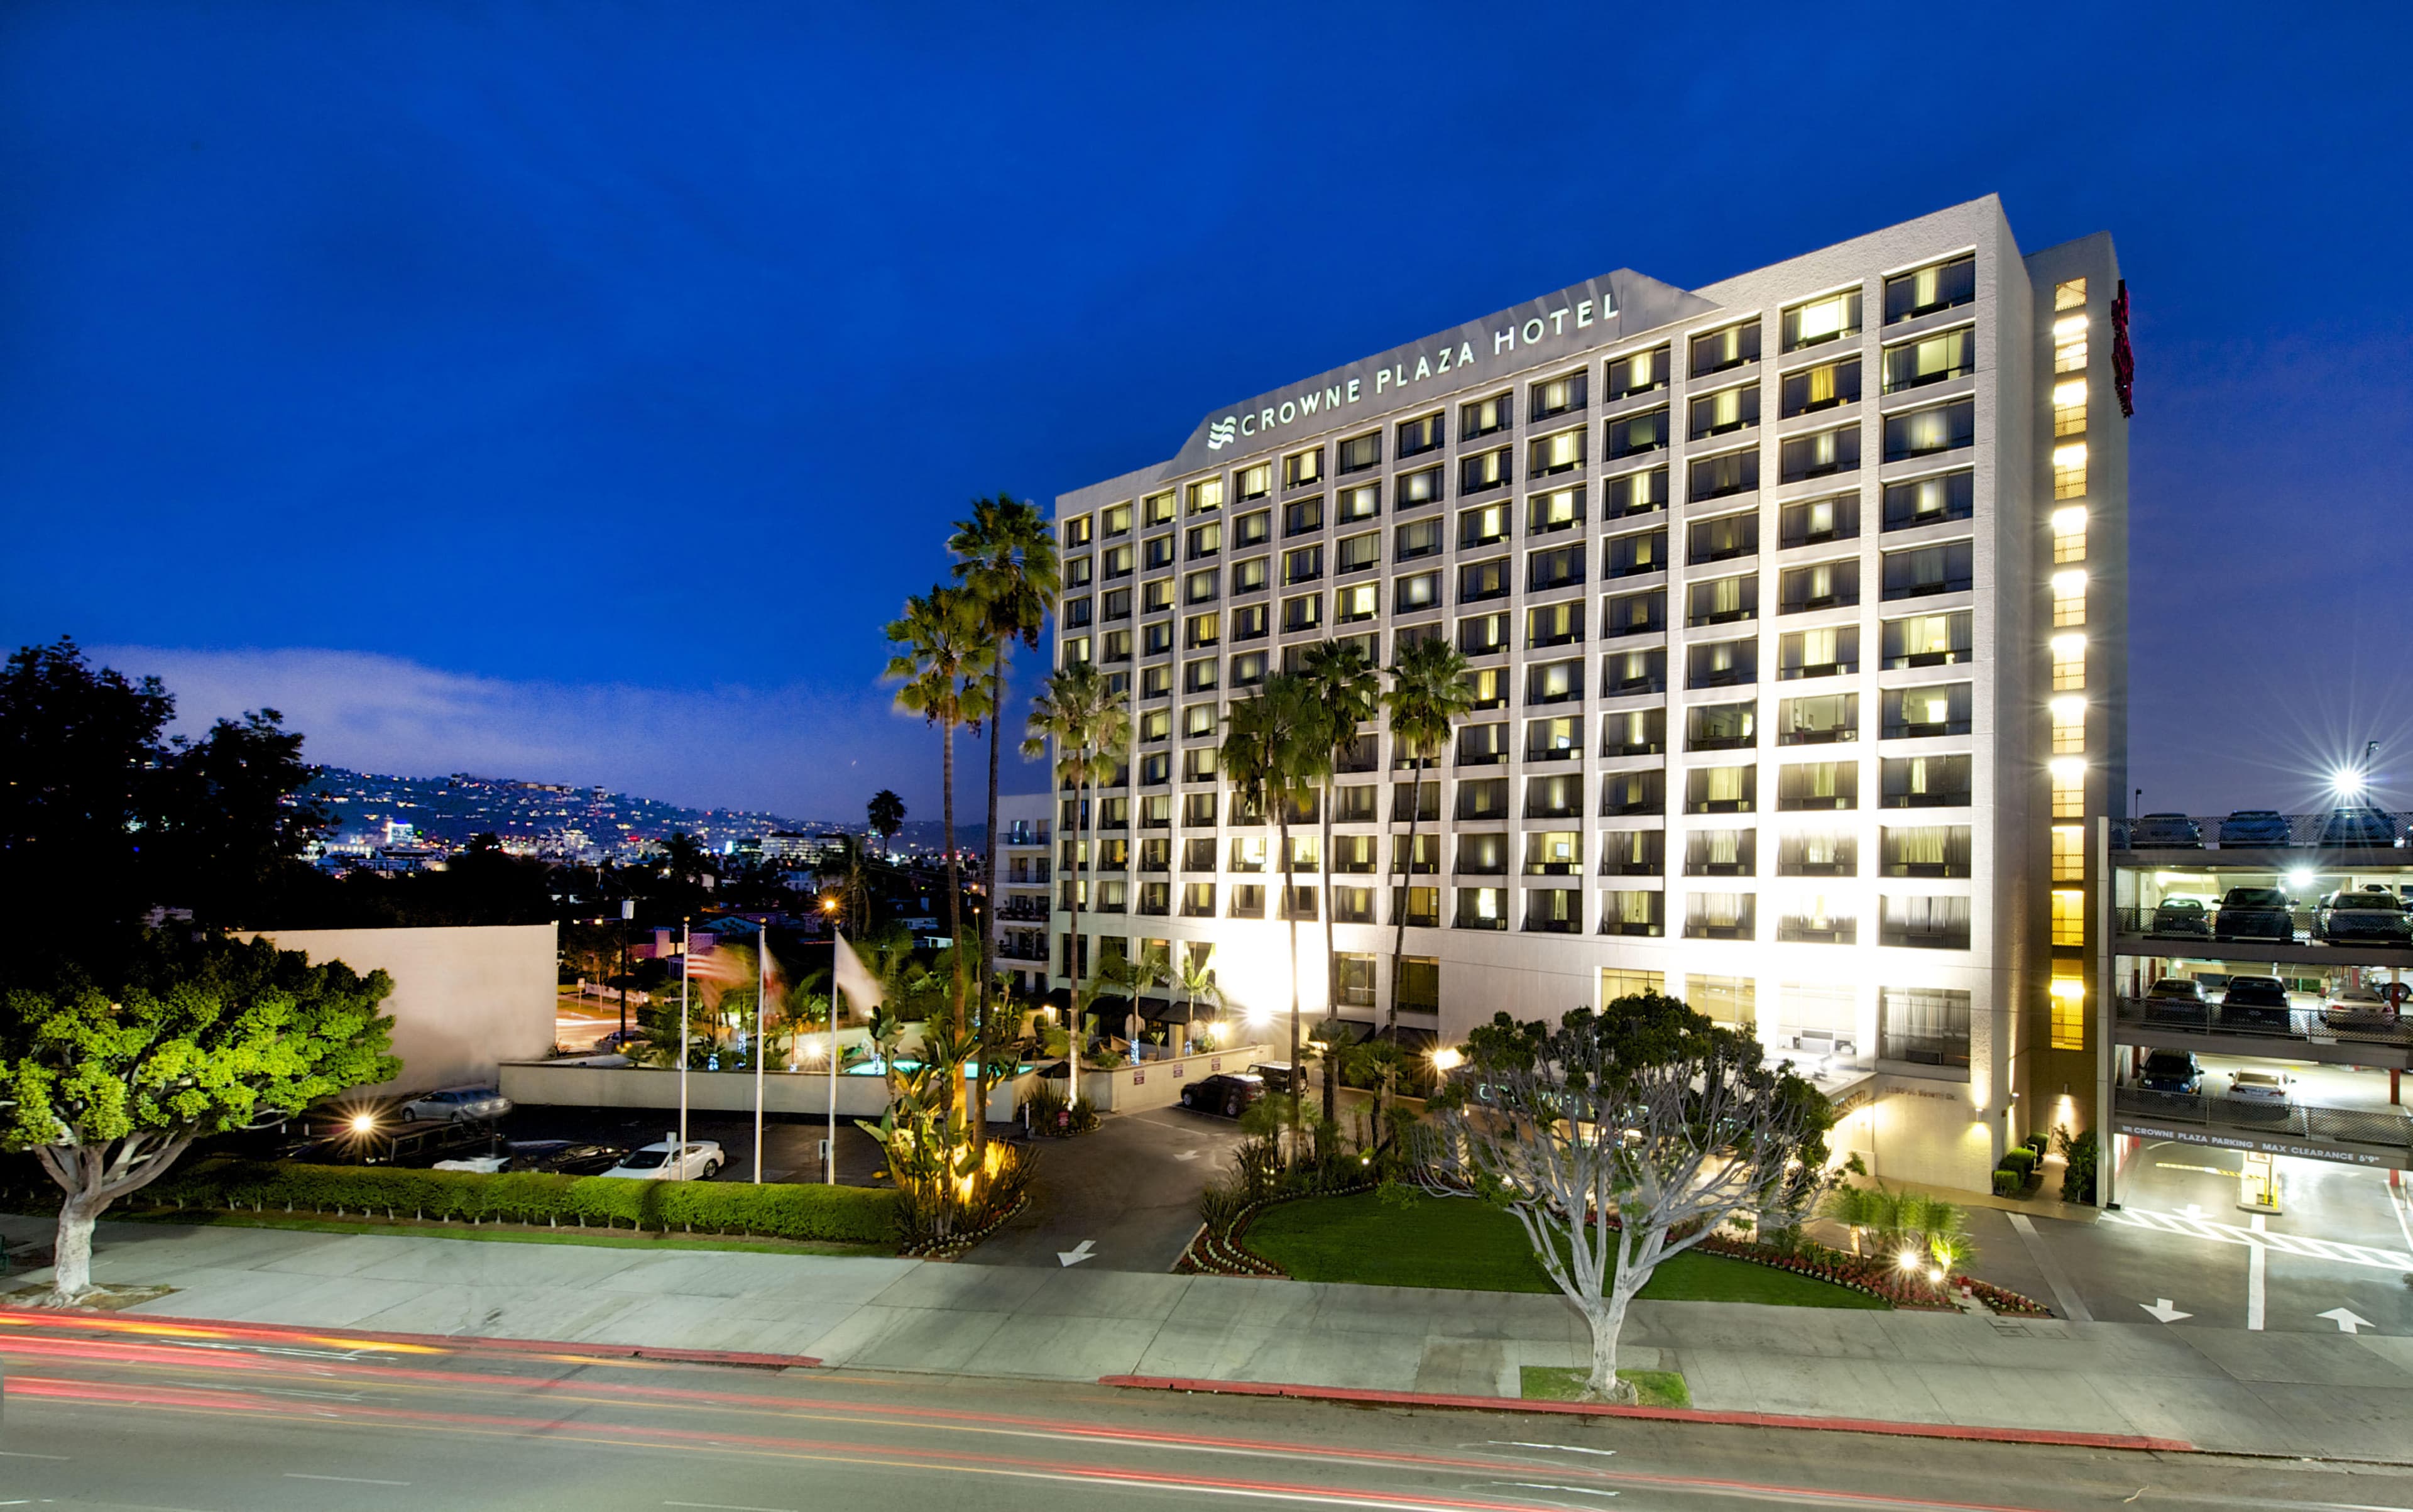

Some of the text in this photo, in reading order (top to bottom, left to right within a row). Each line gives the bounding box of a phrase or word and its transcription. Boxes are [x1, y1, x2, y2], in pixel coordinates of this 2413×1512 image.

[1241, 293, 1619, 436] CROWNE PLAZA HOTEL
[2133, 1127, 2174, 1138] CROWNE
[2178, 1132, 2208, 1142] PLAZA
[2211, 1137, 2254, 1148] PARKING
[2262, 1142, 2287, 1153] MAX
[2291, 1146, 2354, 1161] CLEARANCE
